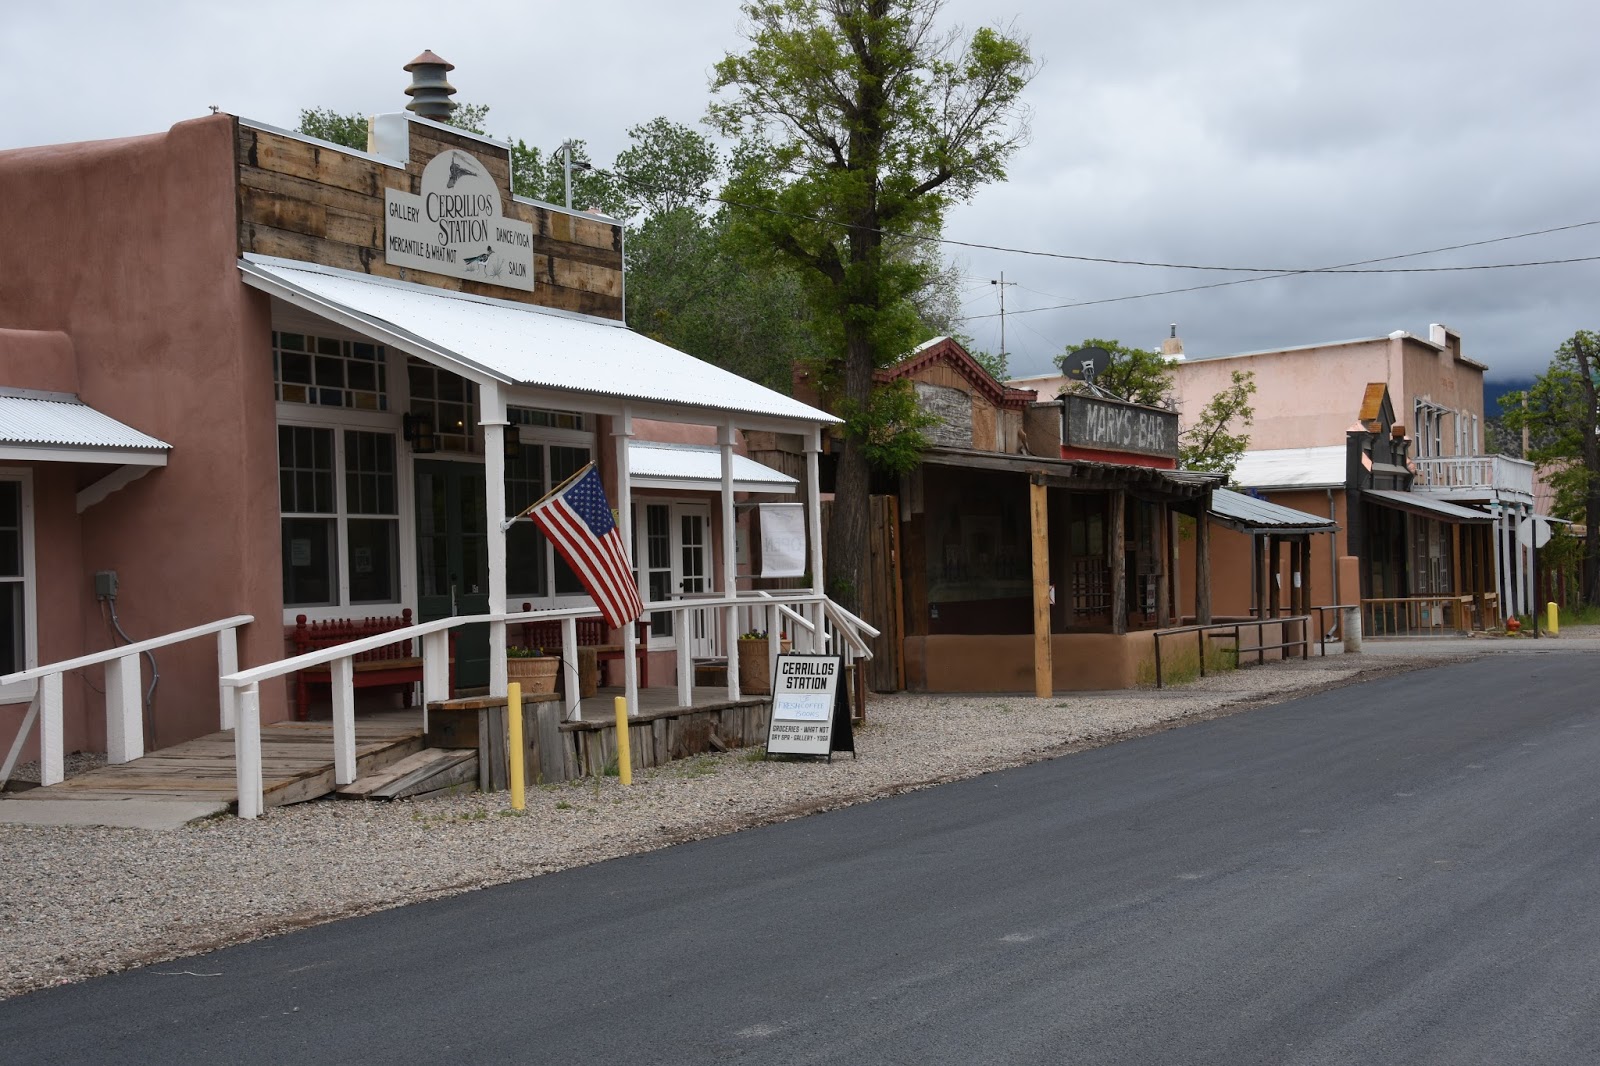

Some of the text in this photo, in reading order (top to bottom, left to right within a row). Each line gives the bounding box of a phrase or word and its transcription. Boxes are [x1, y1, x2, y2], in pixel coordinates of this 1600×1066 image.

[389, 202, 420, 223] GALLERY
[426, 192, 493, 222] CERRILLOS
[438, 219, 488, 246] STATION
[496, 227, 530, 249] DANCE/YOGA
[389, 235, 457, 264] MERCANTILE & WHAT NOT
[508, 261, 527, 278] SALON
[1086, 403, 1165, 450] MARY'S BAR
[782, 662, 835, 675] CERRILLOS
[786, 677, 828, 689] STATION
[771, 733, 781, 741] DAY
[772, 725, 800, 733] GROCERIES
[819, 726, 829, 734] NOT
